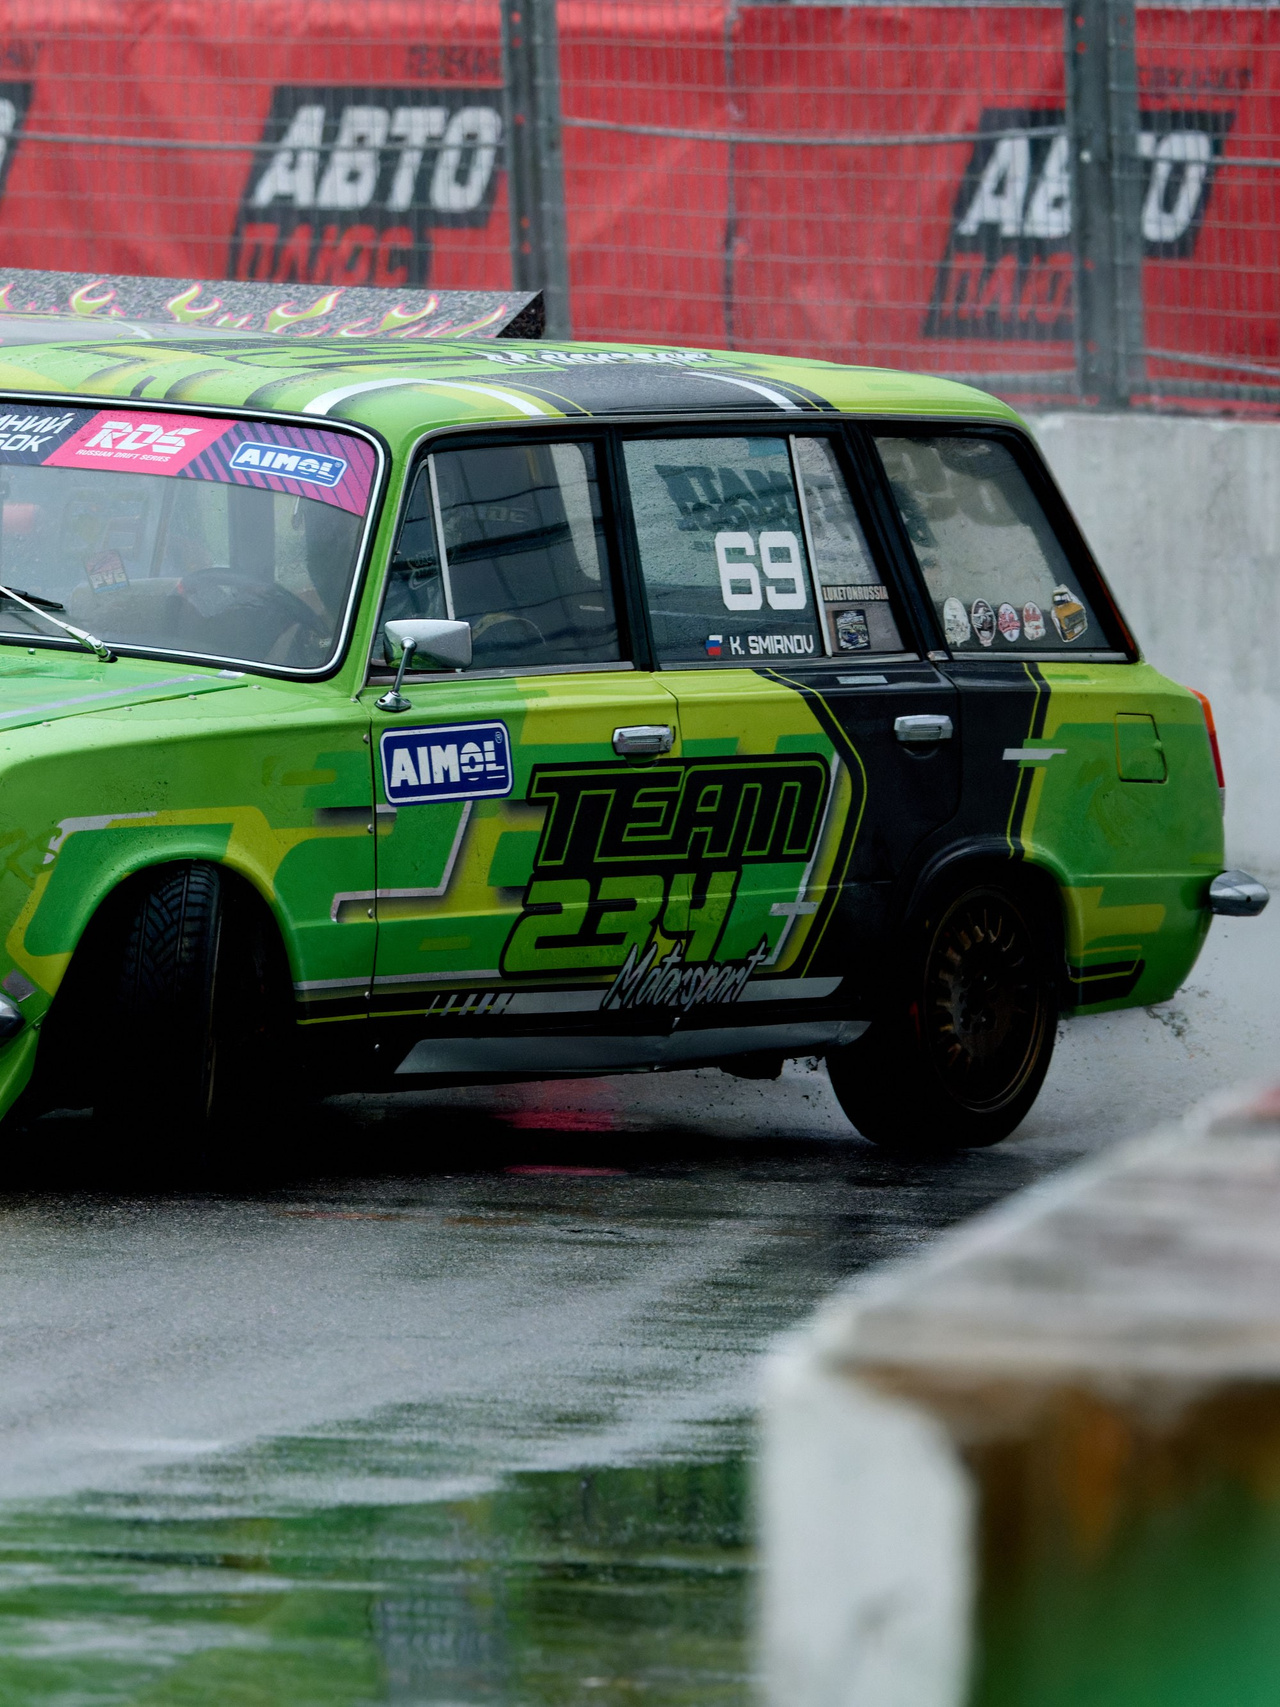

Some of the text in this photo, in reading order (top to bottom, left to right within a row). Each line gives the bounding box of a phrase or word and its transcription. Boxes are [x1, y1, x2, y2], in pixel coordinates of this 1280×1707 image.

[250, 106, 502, 214] АВТО
[958, 130, 1213, 243] АВО
[75, 448, 171, 463] RUSSIAN DRIFT SERIES
[83, 421, 203, 454] RDS
[234, 448, 336, 482] AIMOL
[714, 531, 808, 611] 69
[729, 634, 815, 655] K. SMIRNOV
[390, 740, 506, 787] AIMOL
[529, 761, 825, 867] TEAM
[502, 871, 739, 976] 234
[602, 940, 767, 1013] Motorsport
